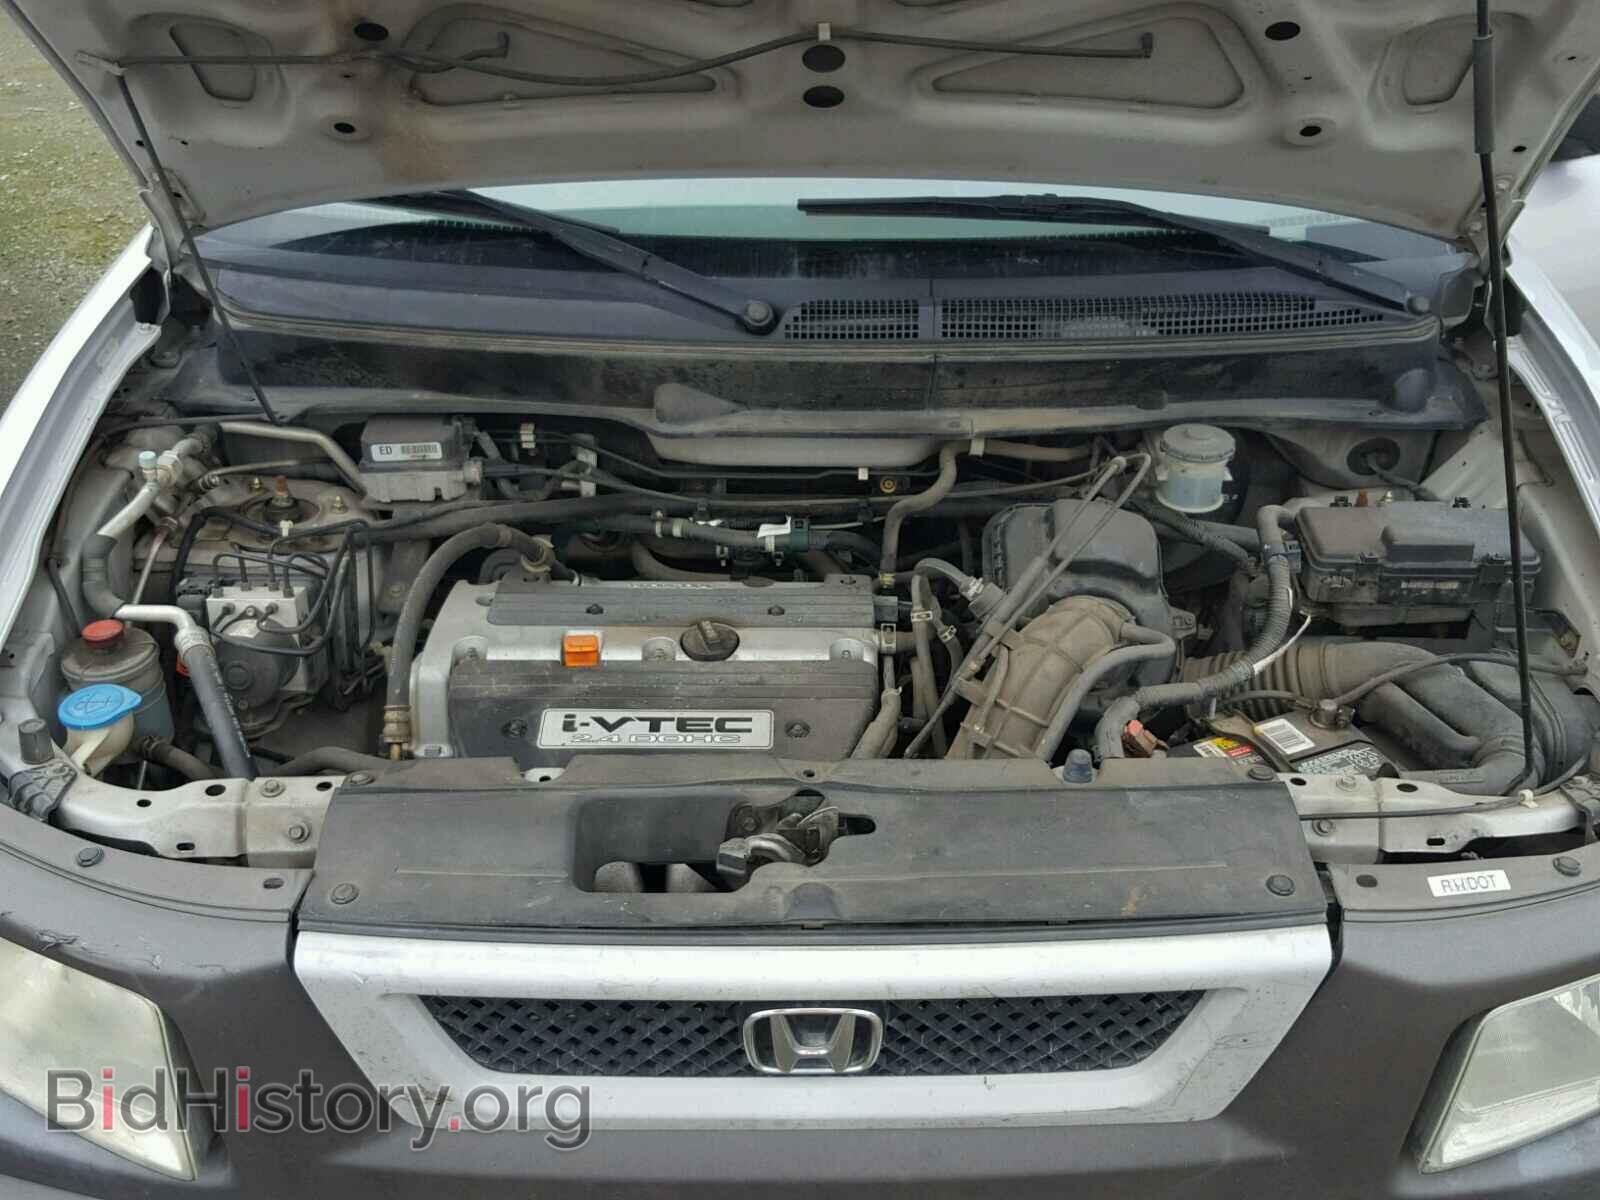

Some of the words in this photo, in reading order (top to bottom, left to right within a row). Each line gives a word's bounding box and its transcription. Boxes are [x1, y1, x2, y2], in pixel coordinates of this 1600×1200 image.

[380, 445, 393, 456] ED
[562, 713, 753, 733] i-VTEC
[629, 734, 741, 744] DOHC
